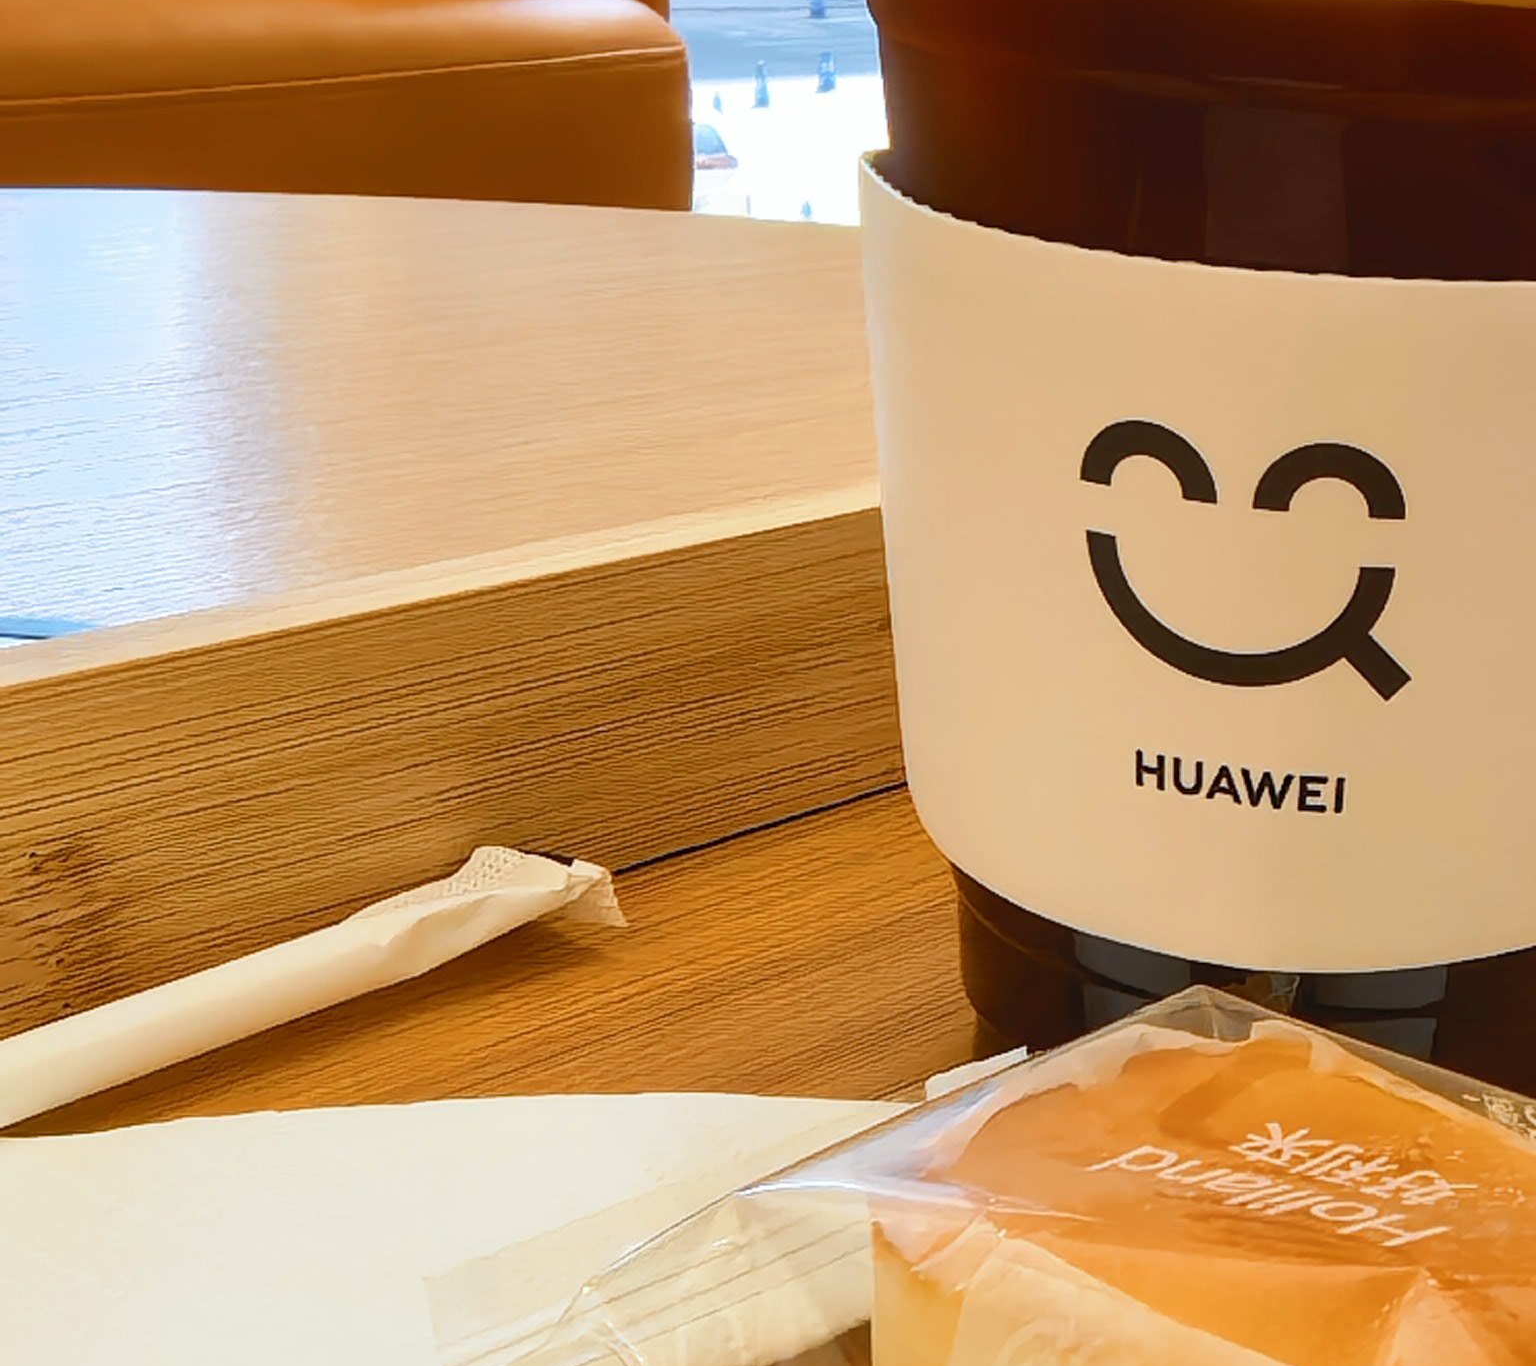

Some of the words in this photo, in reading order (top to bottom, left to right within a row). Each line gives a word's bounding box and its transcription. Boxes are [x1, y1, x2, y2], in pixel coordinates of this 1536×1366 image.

[1134, 749, 1346, 814] HUAWEI
[1086, 1145, 1452, 1248] Holiland
[1228, 1122, 1477, 1206] 好利来
